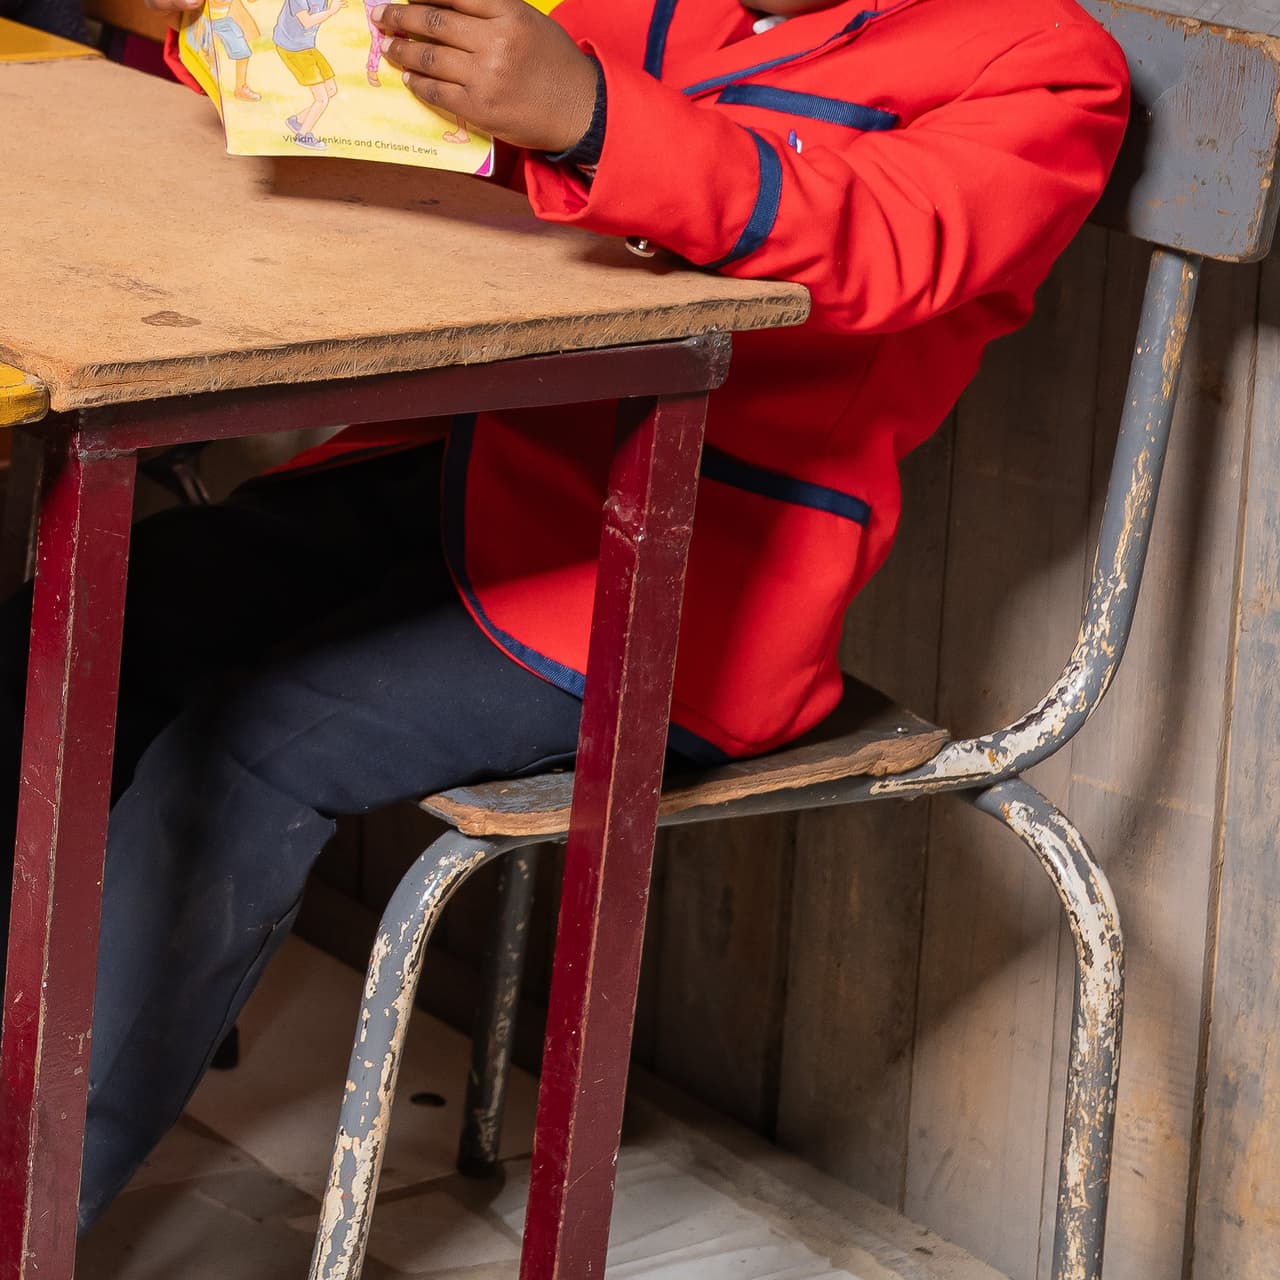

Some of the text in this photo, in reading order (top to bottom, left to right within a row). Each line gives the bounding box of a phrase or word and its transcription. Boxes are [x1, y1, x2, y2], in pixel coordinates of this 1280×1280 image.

[283, 134, 438, 157] Vivian Jenkins and Chrissie Lewis
